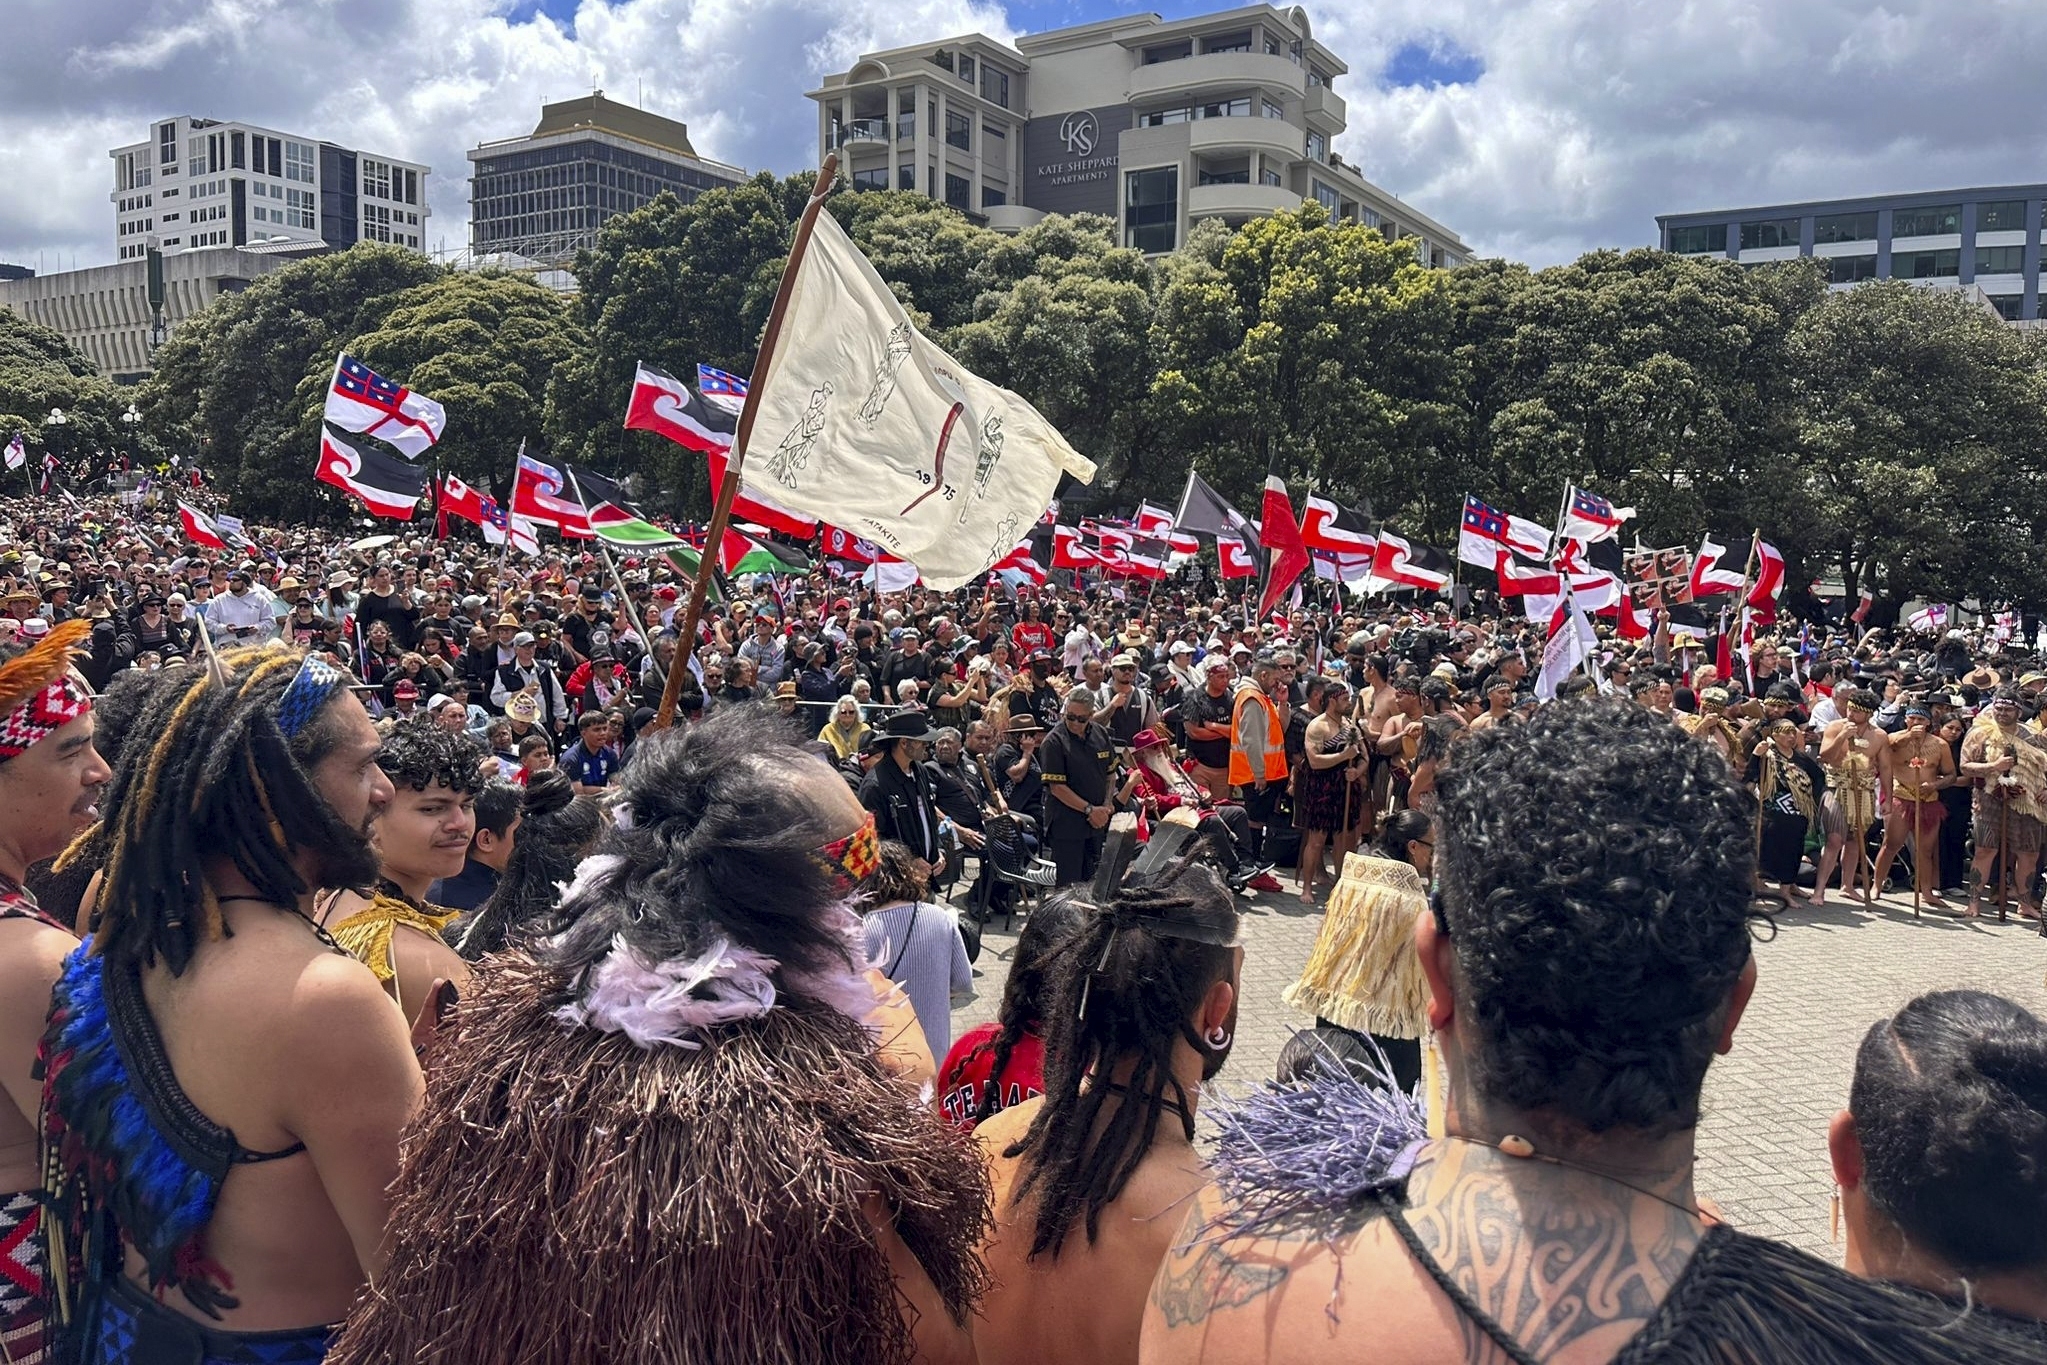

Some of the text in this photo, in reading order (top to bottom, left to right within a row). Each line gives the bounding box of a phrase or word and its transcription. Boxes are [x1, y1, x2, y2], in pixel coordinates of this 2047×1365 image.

[1066, 119, 1093, 157] KS
[1038, 164, 1063, 176] KATE
[1050, 171, 1108, 185] APARTMENTS
[915, 469, 957, 501] 19 75
[610, 544, 644, 556] MANA
